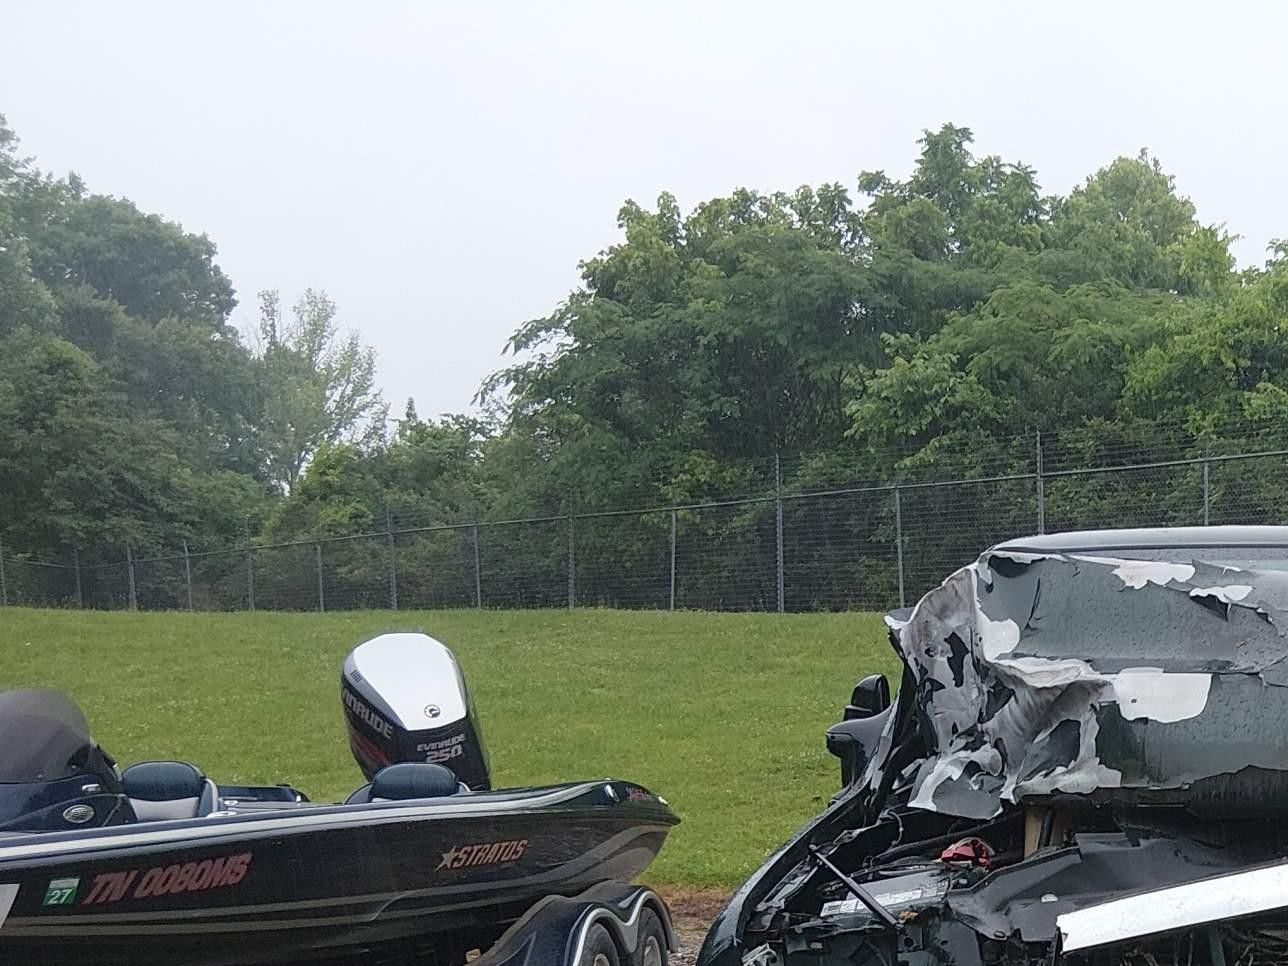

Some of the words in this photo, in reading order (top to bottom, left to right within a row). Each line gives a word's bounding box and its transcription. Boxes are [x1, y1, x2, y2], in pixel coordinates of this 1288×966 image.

[417, 734, 466, 752] EVINRUDE
[426, 745, 463, 763] 250
[452, 839, 528, 868] STRATOS
[49, 888, 73, 904] 27
[81, 870, 138, 904] TN
